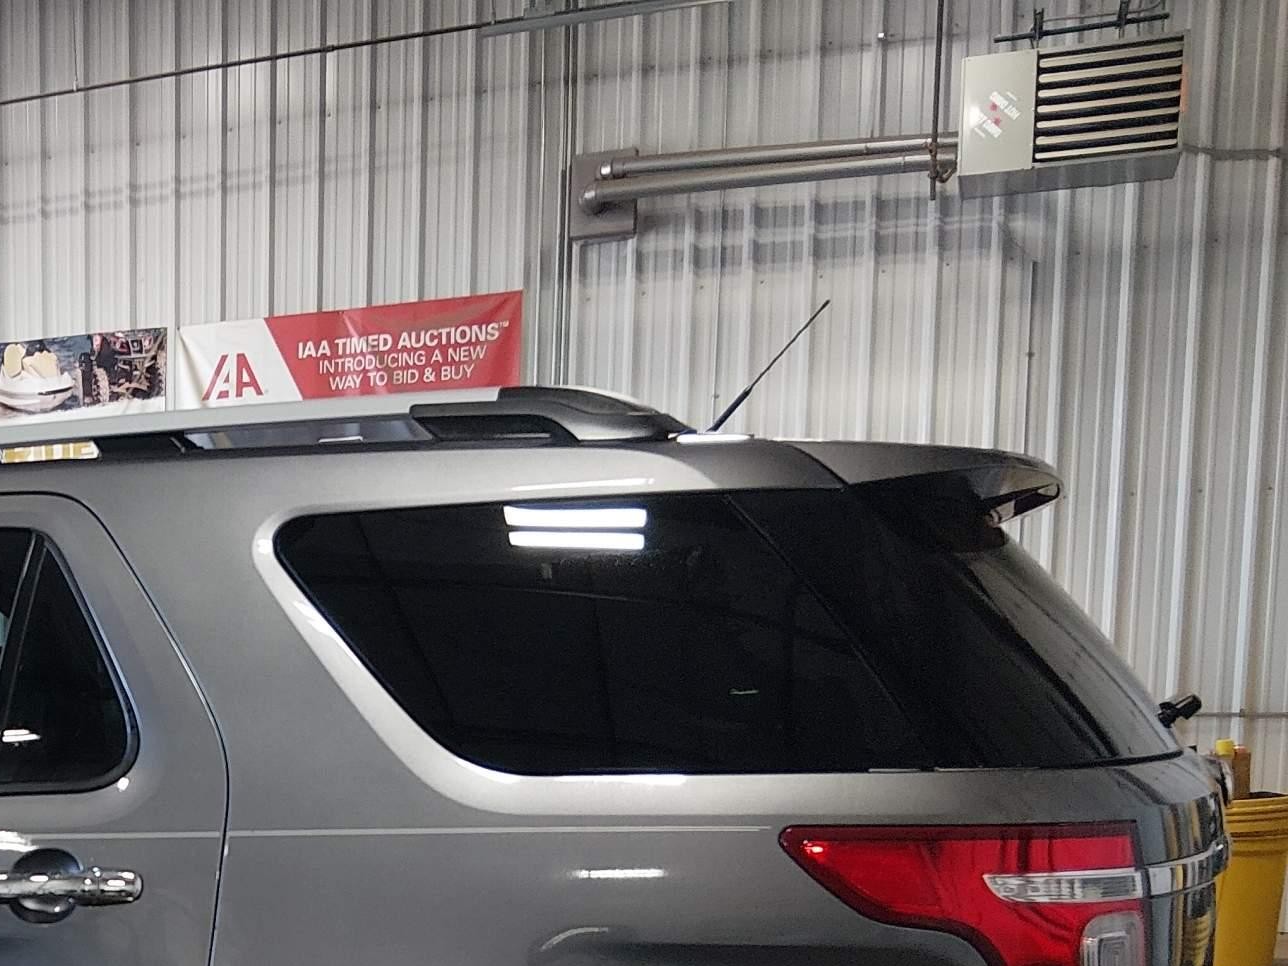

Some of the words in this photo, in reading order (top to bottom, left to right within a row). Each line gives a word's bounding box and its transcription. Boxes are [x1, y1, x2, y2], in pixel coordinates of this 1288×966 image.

[298, 339, 331, 359] IAA
[334, 333, 392, 356] TIMED
[319, 350, 426, 375] INTRODUCING
[430, 348, 443, 365] A
[447, 344, 487, 363] NEW
[329, 373, 363, 391] WAY
[367, 370, 388, 387] TO
[393, 368, 419, 385] BID
[422, 366, 436, 383] &
[441, 363, 475, 381] BUY
